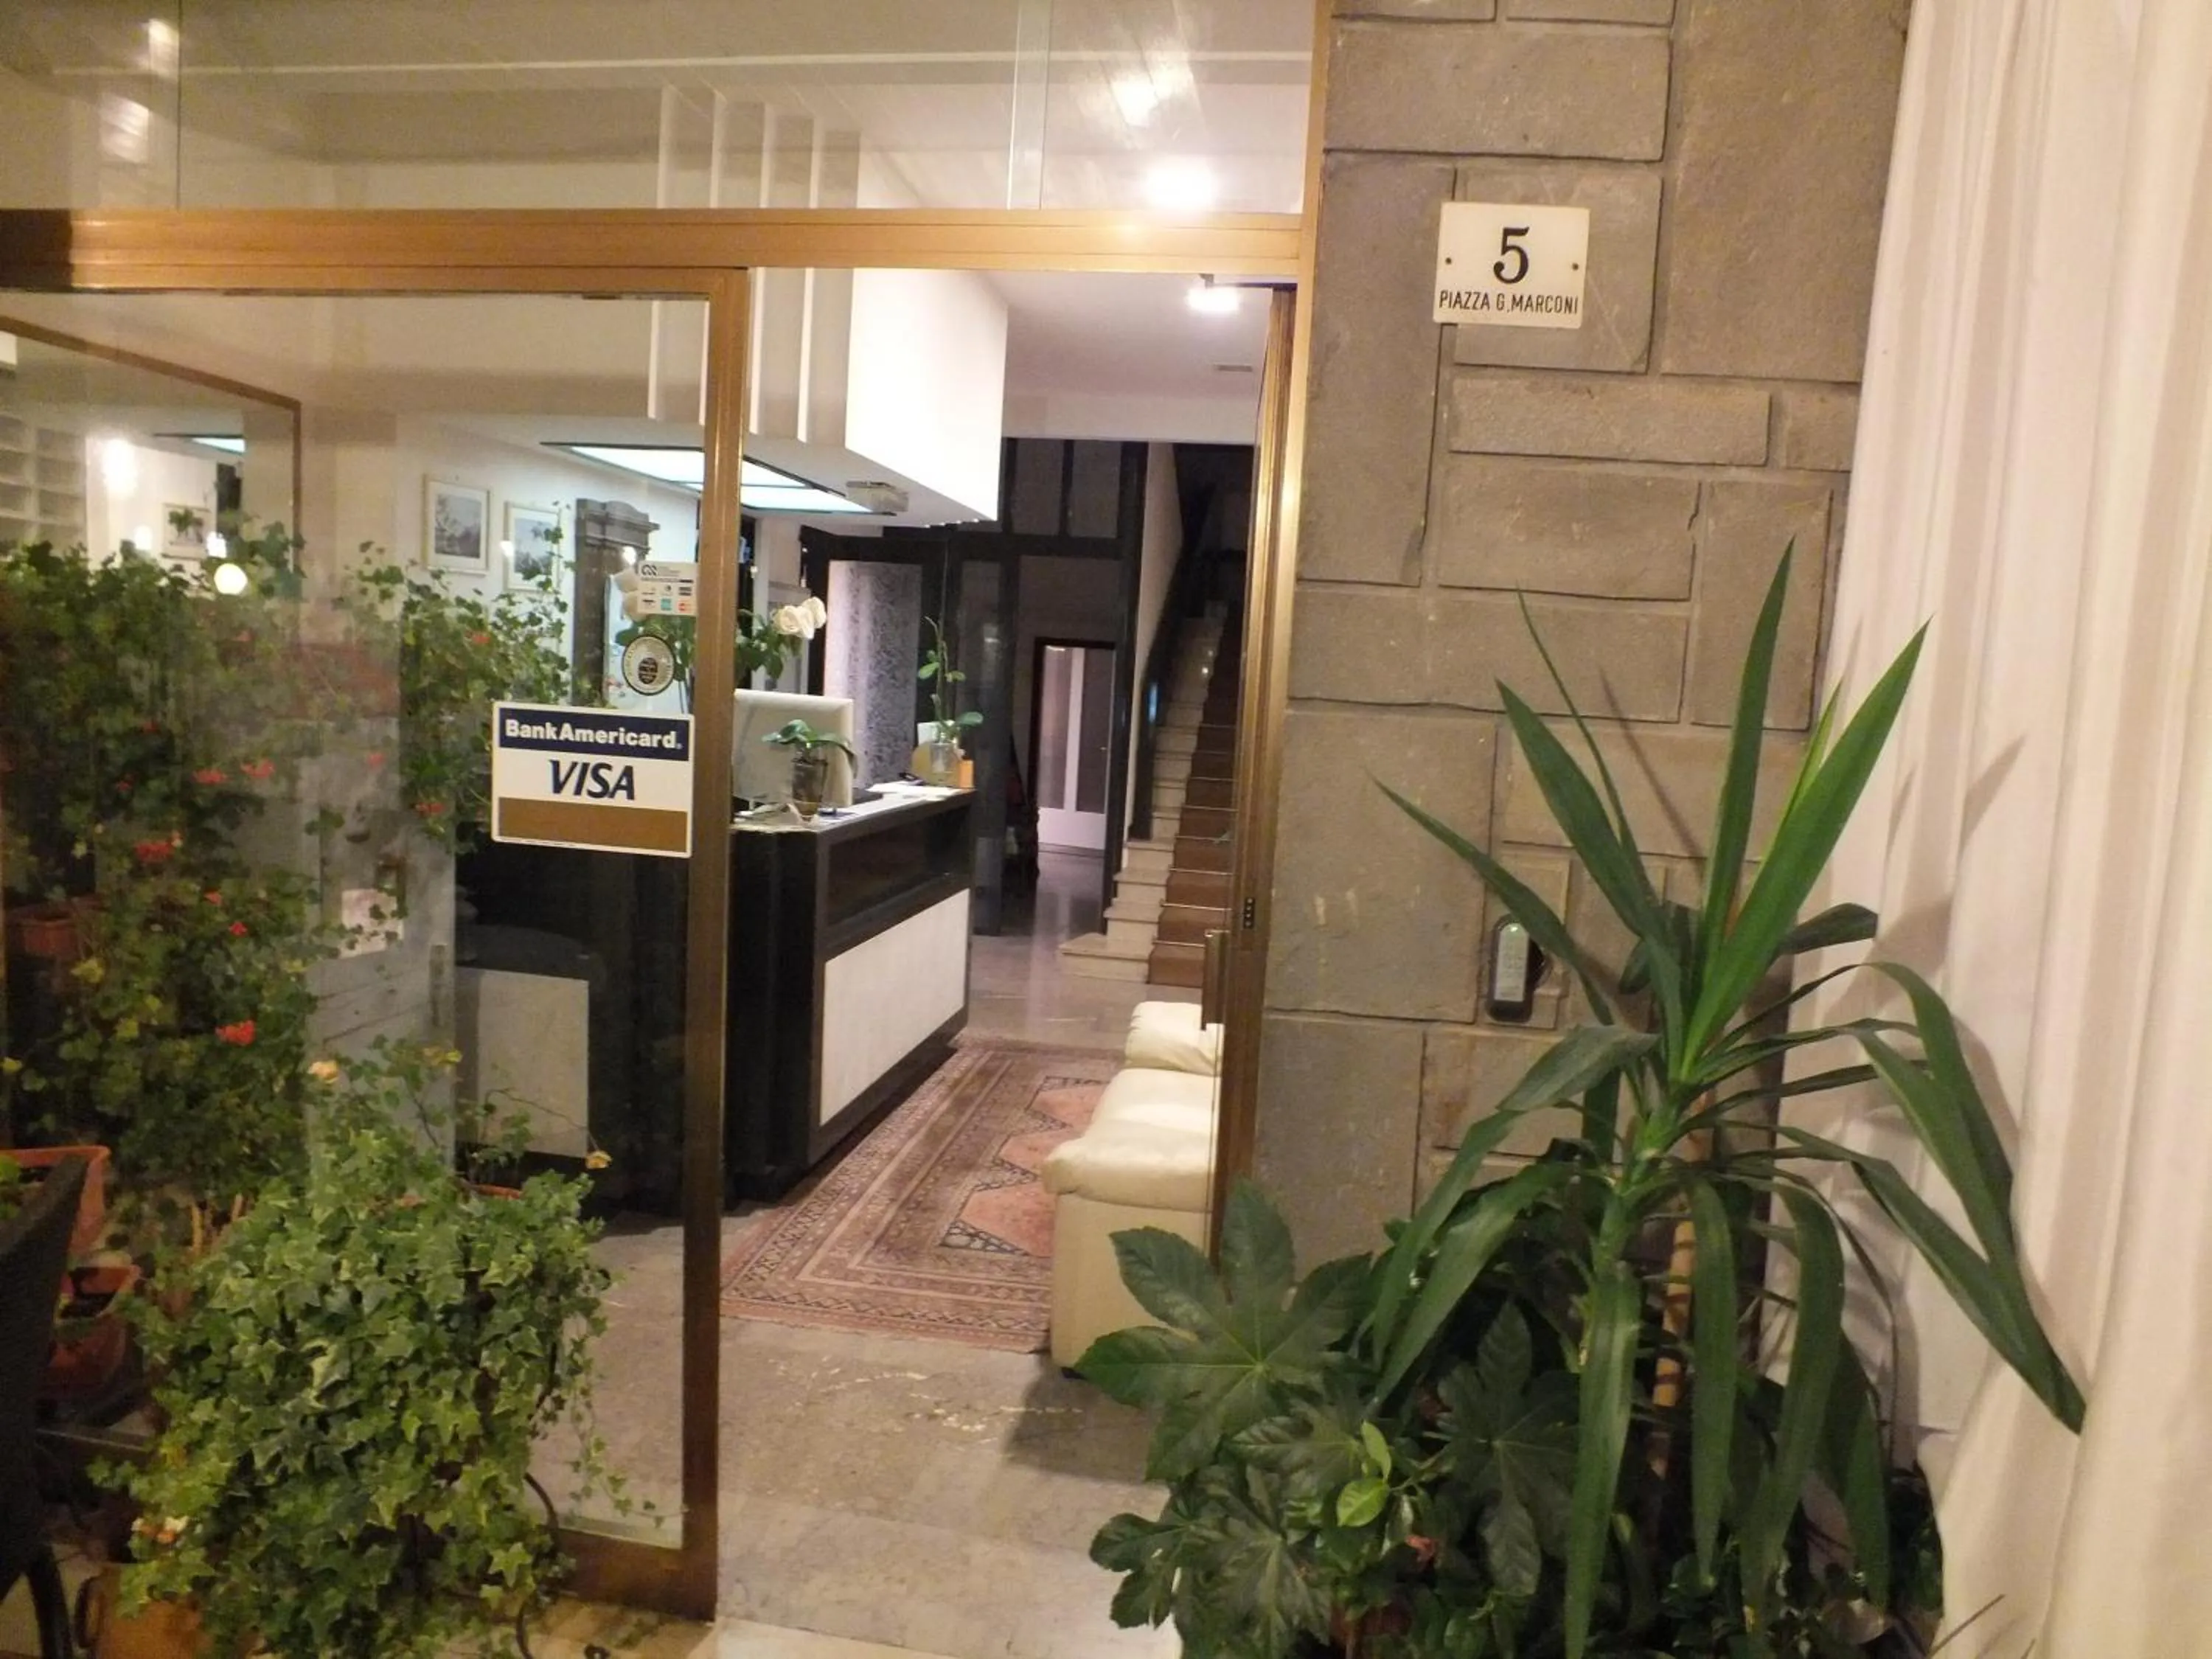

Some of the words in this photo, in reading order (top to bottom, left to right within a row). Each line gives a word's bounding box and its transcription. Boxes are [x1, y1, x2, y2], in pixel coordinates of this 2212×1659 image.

[1493, 226, 1530, 284] 5
[1439, 290, 1490, 311] PIAZZA
[549, 759, 635, 800] VISA
